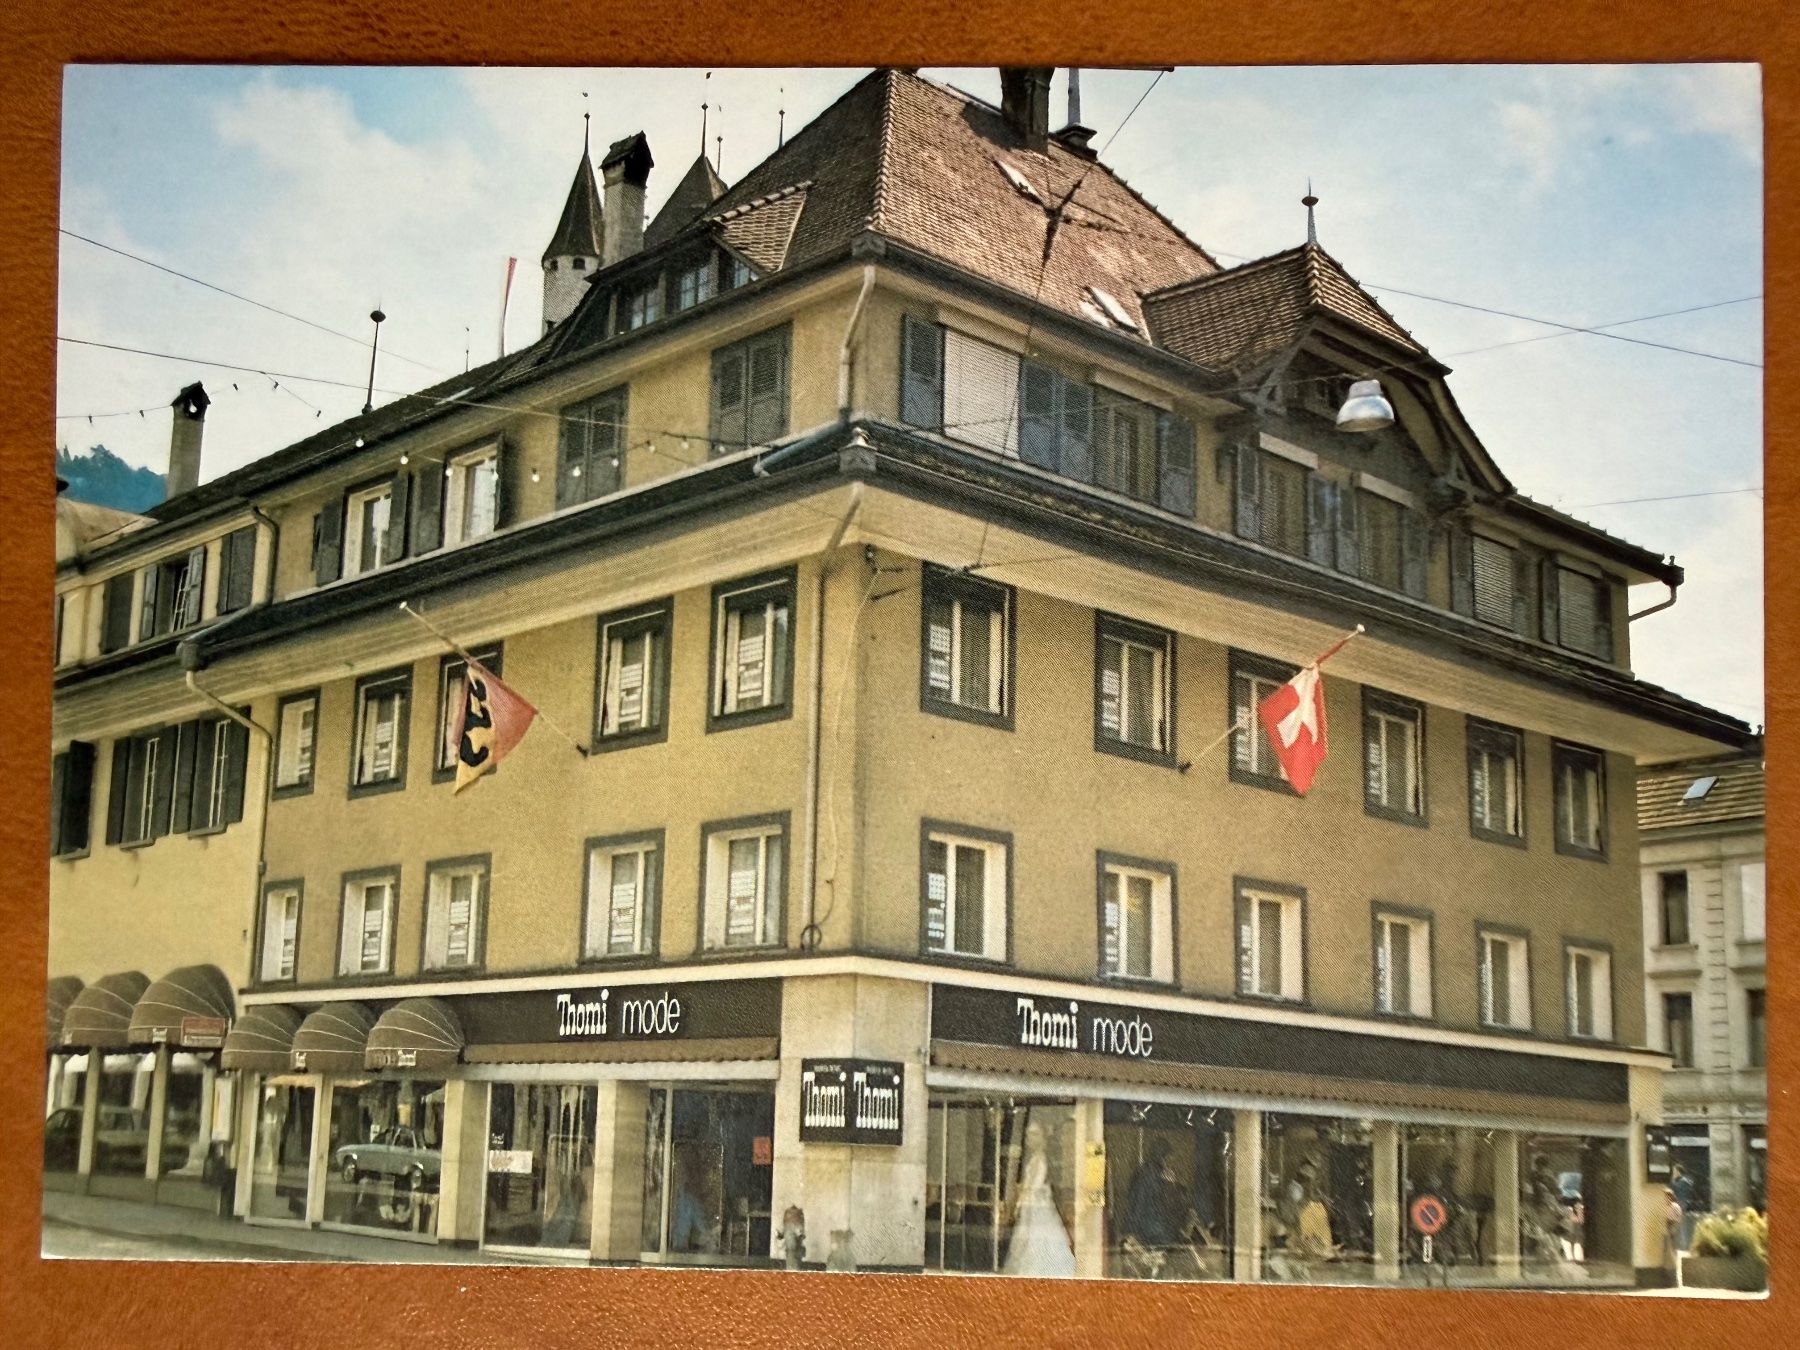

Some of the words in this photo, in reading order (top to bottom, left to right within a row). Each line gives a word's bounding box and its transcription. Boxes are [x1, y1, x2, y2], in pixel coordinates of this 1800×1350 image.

[557, 989, 609, 1036] Thomi
[622, 991, 680, 1034] mode
[1017, 998, 1078, 1049] Thomi
[1093, 1014, 1153, 1057] mode
[803, 1071, 847, 1128] Thomi
[853, 1071, 900, 1130] Thomi
